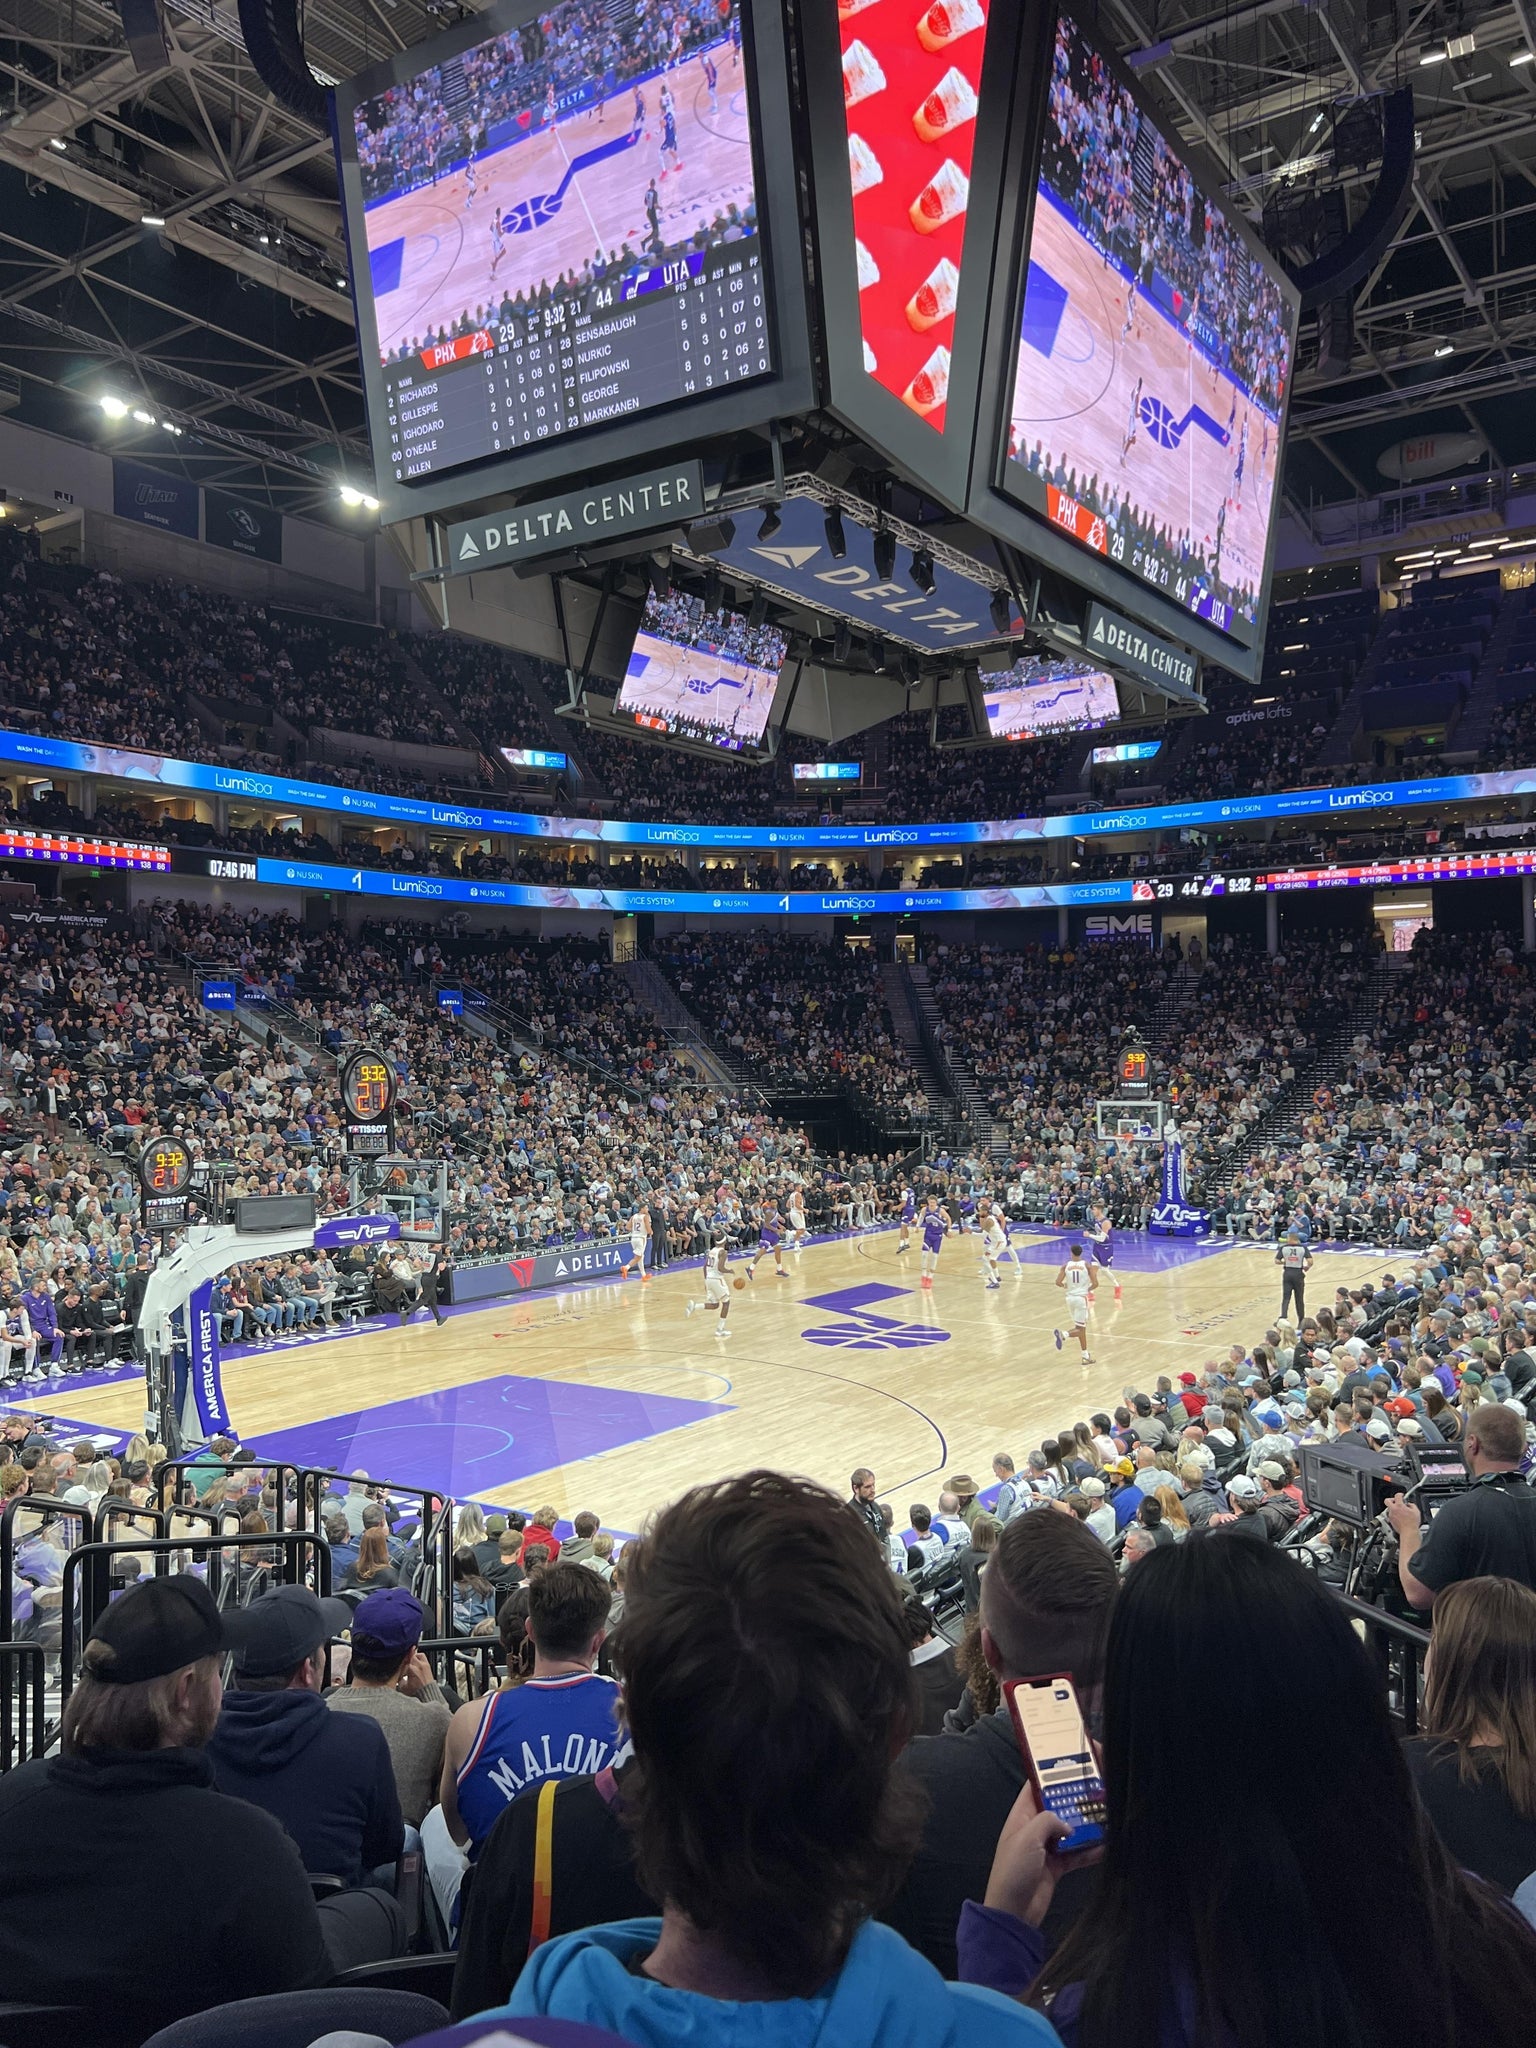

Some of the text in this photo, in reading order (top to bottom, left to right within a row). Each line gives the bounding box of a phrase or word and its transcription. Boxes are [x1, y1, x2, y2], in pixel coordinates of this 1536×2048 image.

[576, 256, 758, 327] NAME PTS REB AST MIN PF
[434, 260, 689, 365] PHX 29 2ND 9:32 21 44 UTA
[560, 274, 757, 350] 28 SENSABAUGH 3 1 1 06 1
[562, 295, 760, 369] 30 NURKIC 5 8 1 07 0
[564, 317, 762, 388] 22 FILIPOWSKI 0 3 0 07 0
[388, 345, 552, 408] 2 RICHARDS 0 1 0 02 1
[568, 338, 764, 407] 3 GEORGE 8 0 2 06 2
[389, 363, 555, 426] 12 GILLESPIE 3 1 5 08 0
[568, 359, 766, 428] 23 MARKKANEN 14 3 1 12 0
[392, 383, 556, 443] 11 IGHODARO 2 0 0 06 1
[392, 403, 557, 461] 00 O'NEALE 0 5 1 10 1
[396, 422, 560, 479] 8 ALLEN 8 1 0 09 0
[1406, 440, 1435, 463] bill
[485, 478, 691, 551] DELTA CENTER
[1058, 496, 1078, 529] PHX
[1111, 532, 1124, 560] 29
[1144, 558, 1159, 582] 9:32
[1160, 568, 1168, 586] 21
[1175, 576, 1187, 600] 44
[1211, 600, 1225, 624] UTA
[814, 565, 980, 635] DELTA
[1107, 624, 1192, 685] DELTA CENTER
[1226, 705, 1292, 726] aptive lofts
[215, 773, 273, 795] LumiSpa
[362, 800, 376, 809] SKIN
[1244, 804, 1261, 812] SKIN
[1330, 790, 1393, 807] LumiSpa
[432, 808, 482, 827] LumiSpa
[1092, 815, 1146, 830] LumiSpa
[647, 828, 699, 843] LumiSpa
[864, 830, 918, 843] LumiSpa
[210, 860, 256, 880] 07:46 PM
[307, 872, 323, 880] SKIN
[392, 878, 442, 896] LumiSpa
[1157, 884, 1174, 897] 29
[1182, 882, 1199, 896] 44
[1229, 877, 1251, 893] 9:32
[822, 897, 875, 910] LumiSpa
[1086, 914, 1152, 935] SME
[361, 1066, 386, 1081] 9:32
[1124, 1062, 1144, 1078] 21
[357, 1082, 385, 1112] 21
[360, 1125, 387, 1133] TISSOT
[157, 1152, 182, 1168] 9:32
[154, 1168, 178, 1187] 21
[159, 1196, 188, 1205] TISSOT
[572, 1250, 622, 1272] DELTA
[1073, 1271, 1079, 1283] 11
[200, 1310, 221, 1420] AMERICA FIRST
